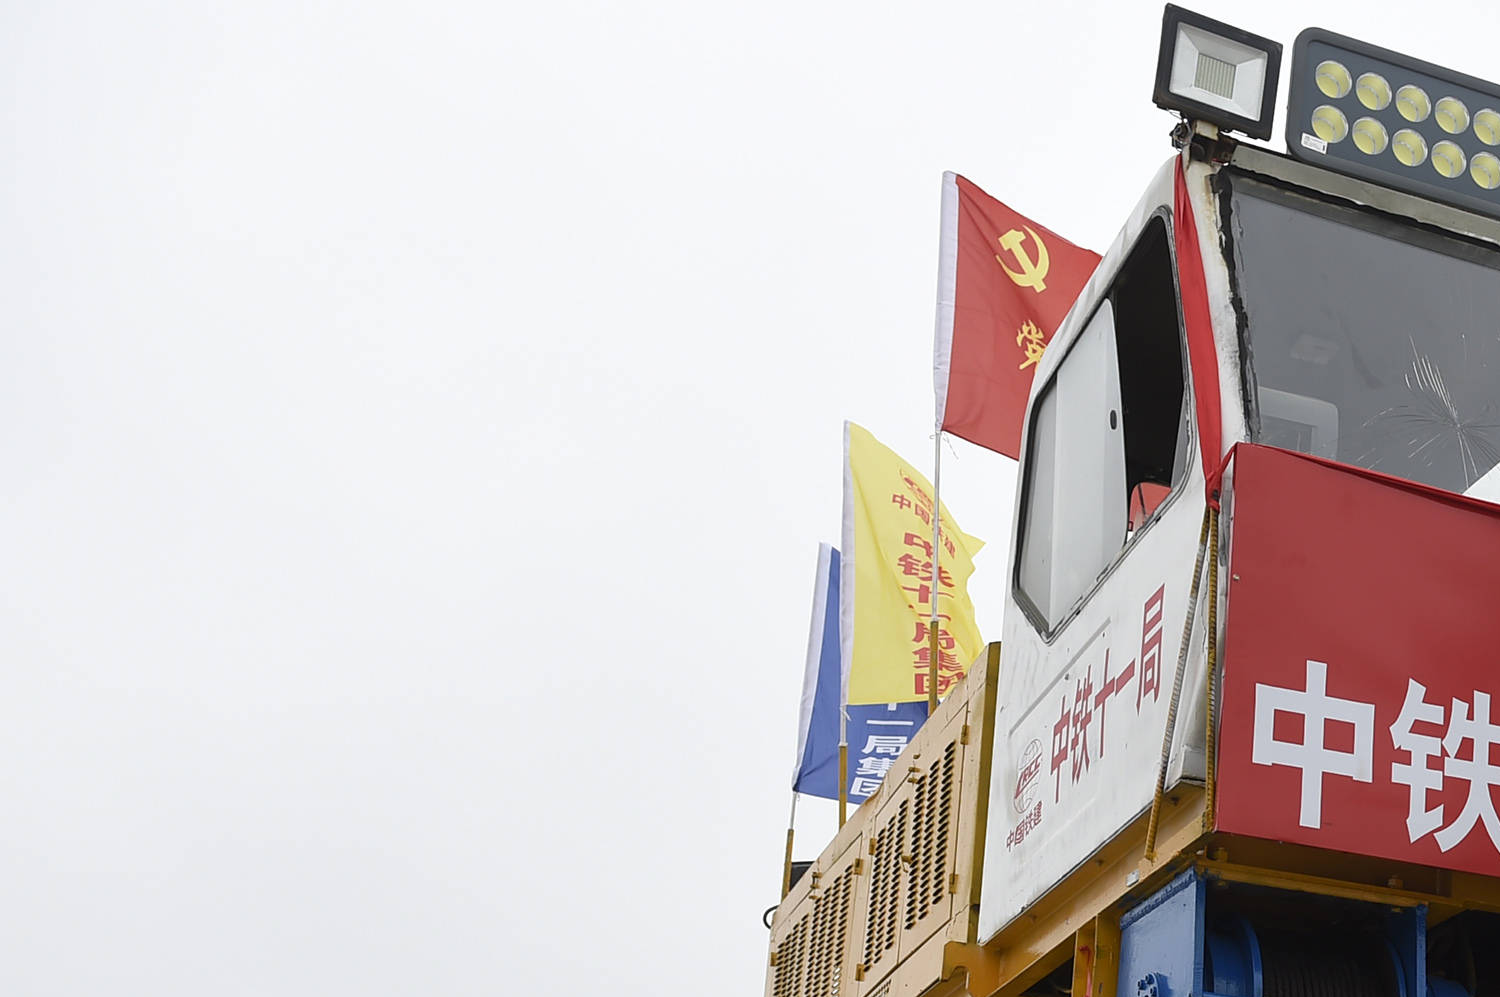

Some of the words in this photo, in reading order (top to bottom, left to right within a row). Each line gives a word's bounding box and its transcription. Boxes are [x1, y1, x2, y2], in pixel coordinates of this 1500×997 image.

[1050, 583, 1165, 803] 中铁十一局
[850, 703, 914, 796] 一局集团
[1006, 800, 1042, 853] 中国铁建
